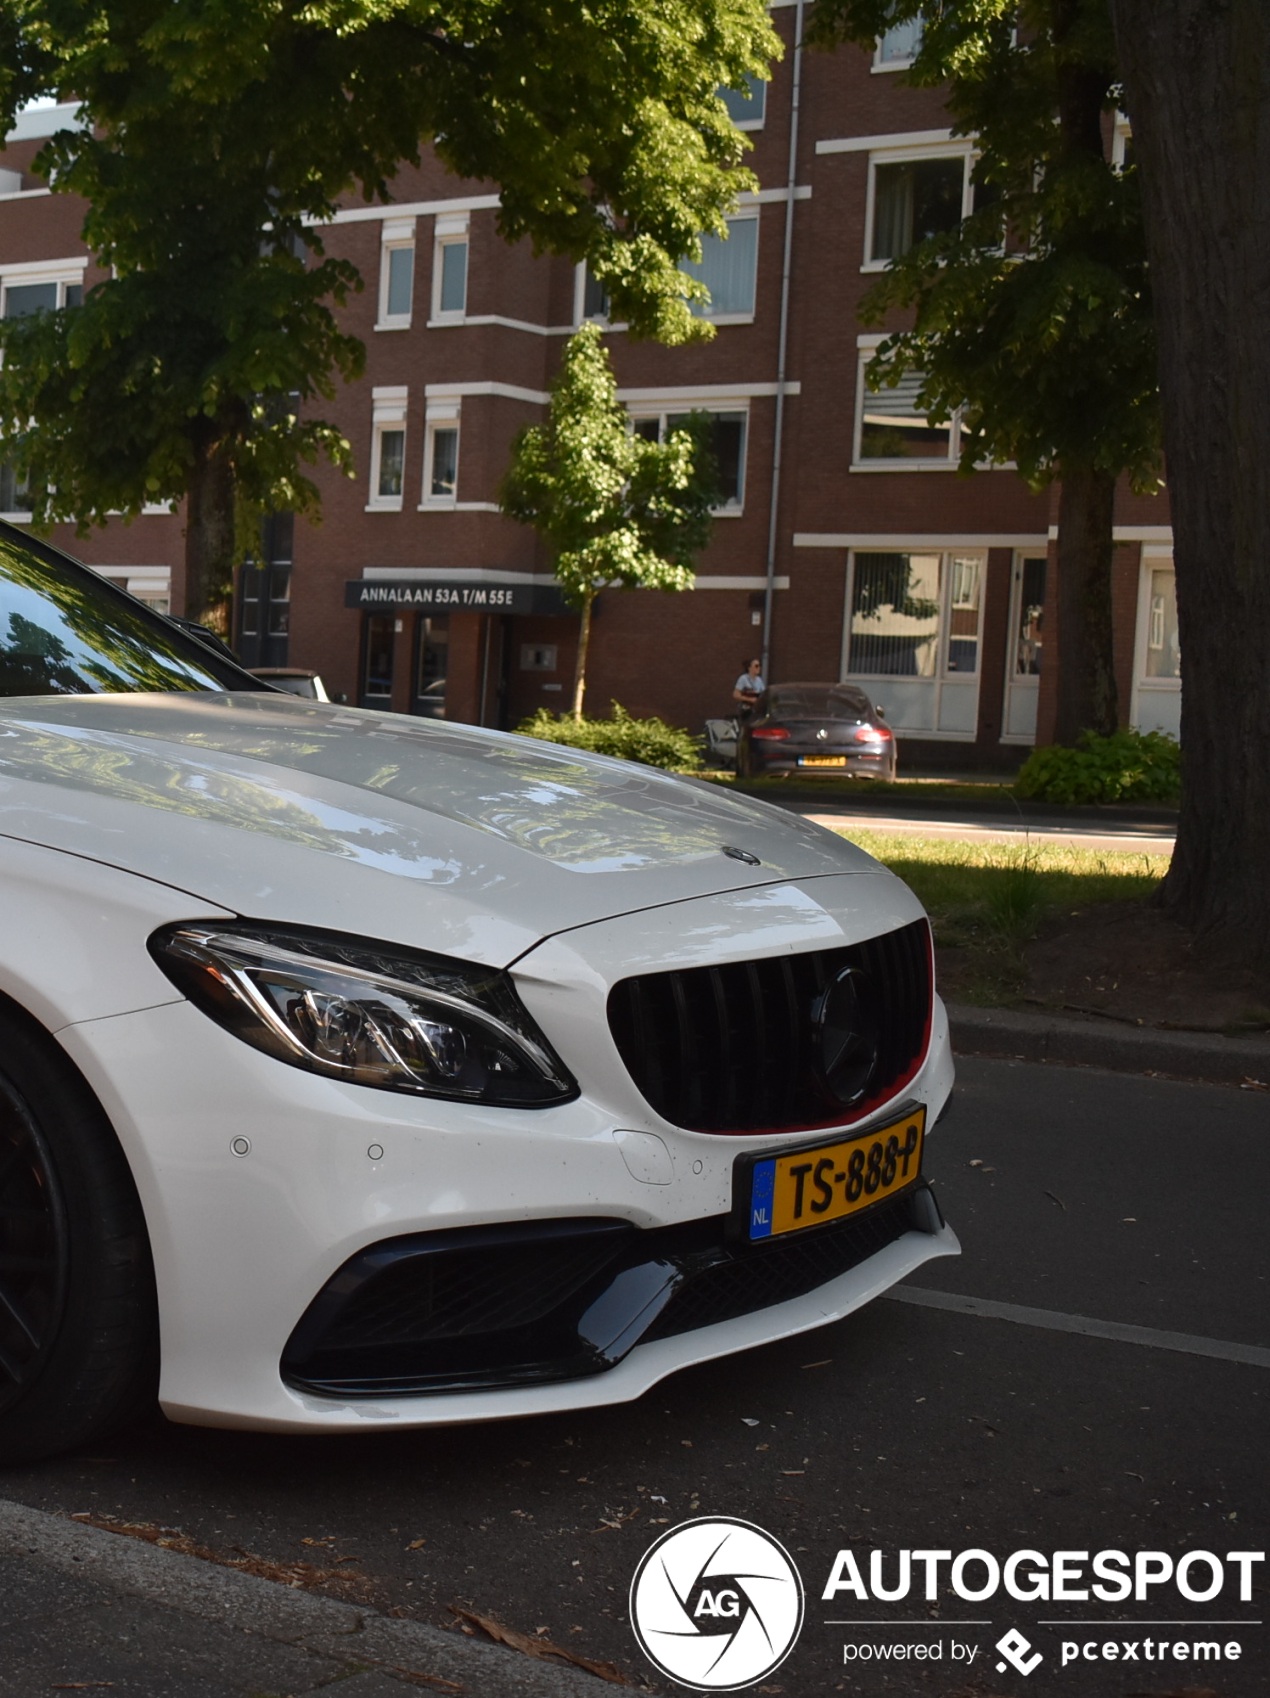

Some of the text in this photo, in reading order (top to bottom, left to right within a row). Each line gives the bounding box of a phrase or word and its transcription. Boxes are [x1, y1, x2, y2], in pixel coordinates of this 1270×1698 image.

[360, 588, 513, 605] ANNALAAN 53A T/M 55E
[790, 1125, 918, 1219] TS-888-P
[753, 1208, 769, 1226] NL
